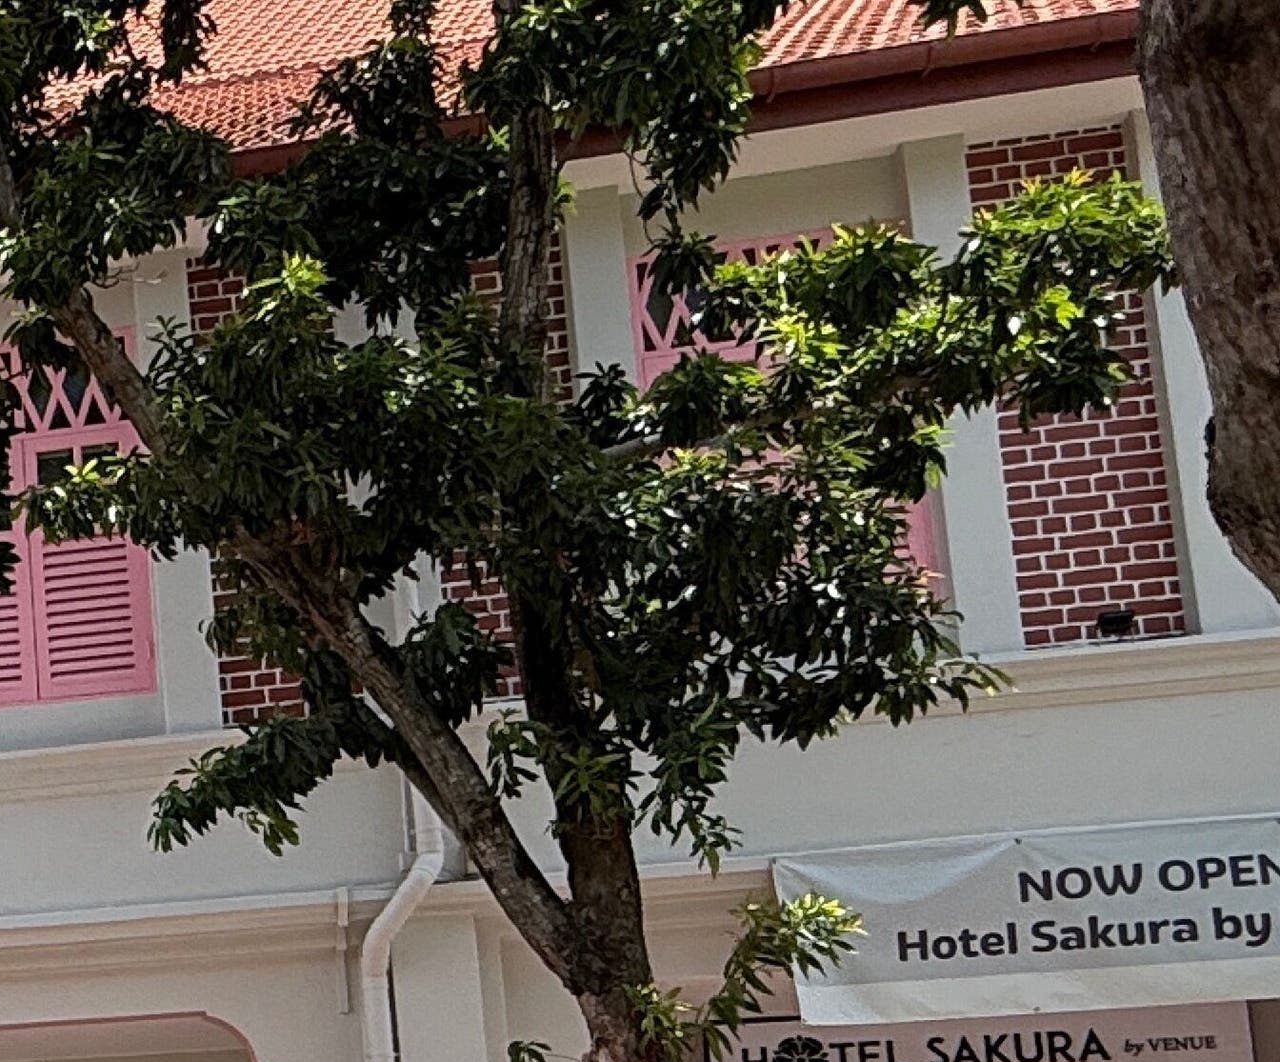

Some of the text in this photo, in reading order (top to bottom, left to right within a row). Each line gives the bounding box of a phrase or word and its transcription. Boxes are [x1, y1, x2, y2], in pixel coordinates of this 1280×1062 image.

[1018, 863, 1142, 903] NOW
[897, 907, 1271, 962] Hotel Sakura by
[1123, 1039, 1144, 1056] by
[1147, 1035, 1217, 1052] VENUE
